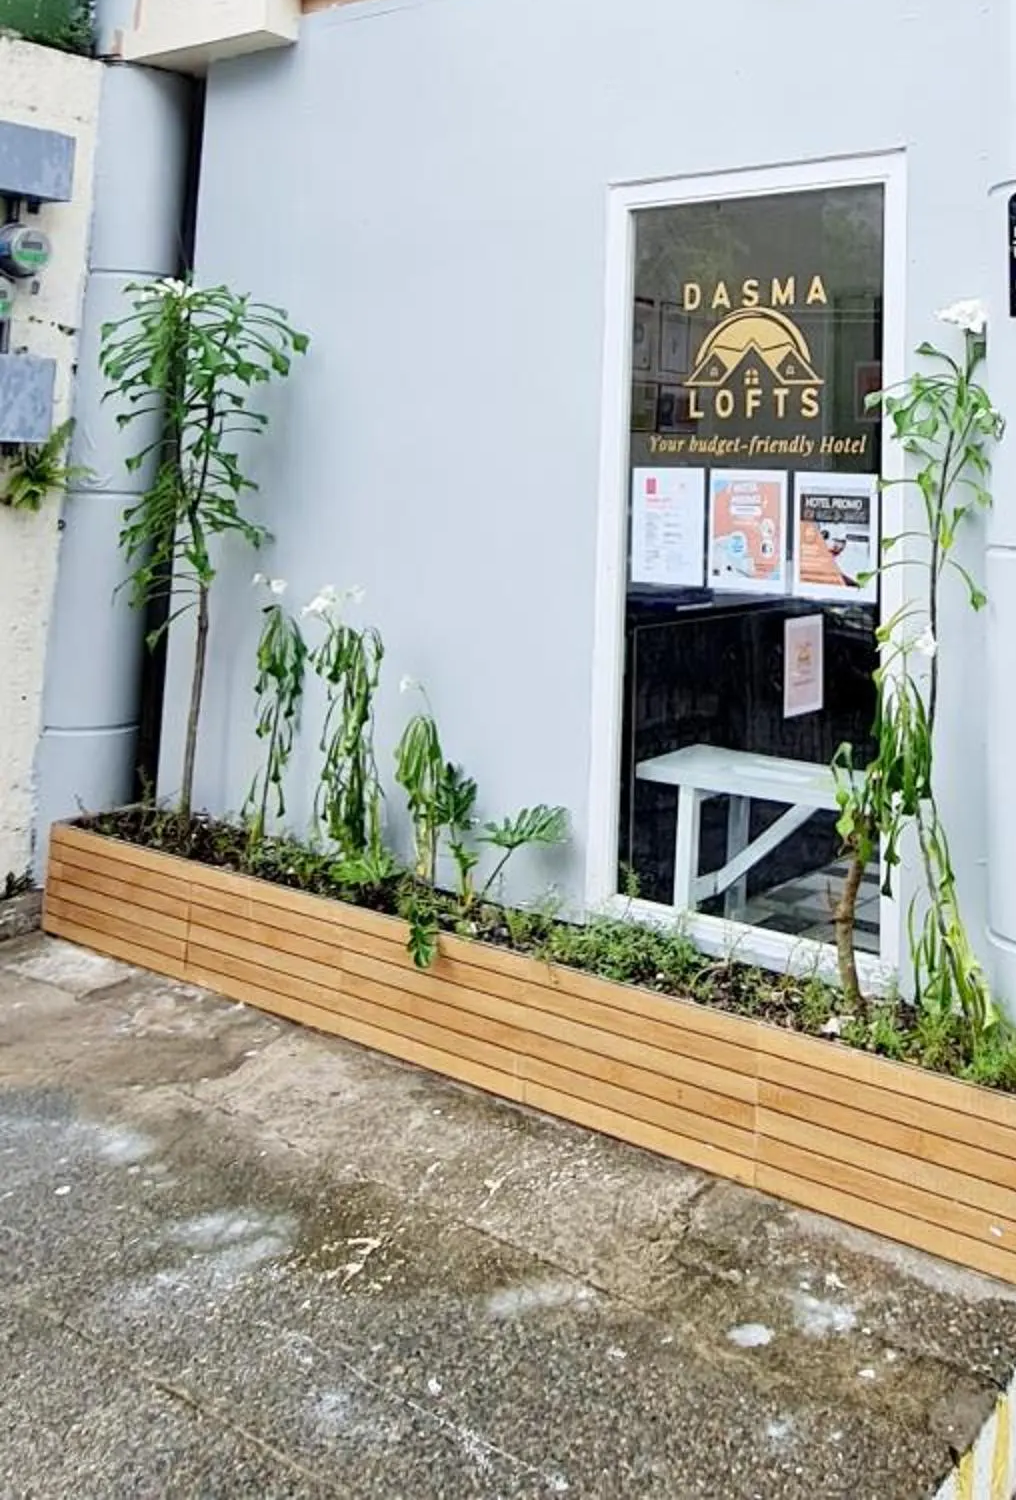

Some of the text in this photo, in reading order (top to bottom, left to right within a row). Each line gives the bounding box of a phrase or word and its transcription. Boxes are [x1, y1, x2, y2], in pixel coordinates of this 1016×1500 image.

[683, 275, 829, 311] DASMA
[688, 387, 820, 419] LOFTS
[650, 434, 867, 457] Your budget-friendly Hotel
